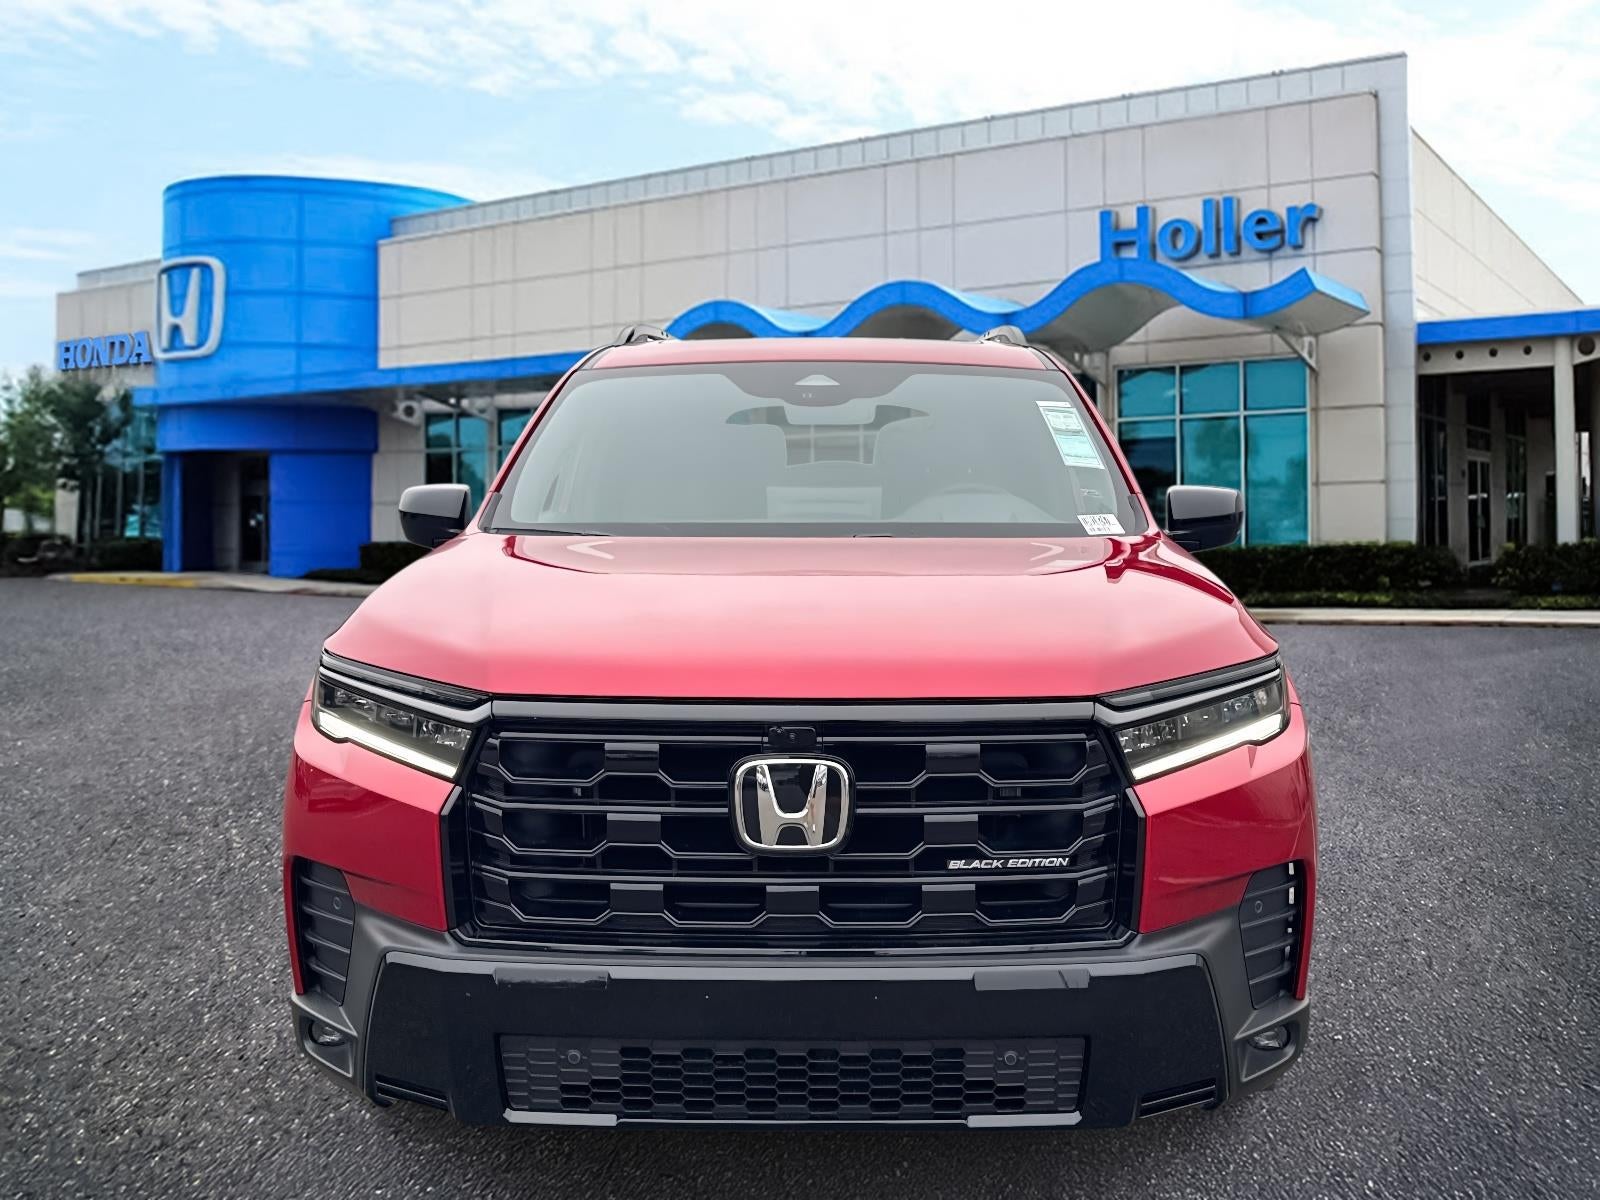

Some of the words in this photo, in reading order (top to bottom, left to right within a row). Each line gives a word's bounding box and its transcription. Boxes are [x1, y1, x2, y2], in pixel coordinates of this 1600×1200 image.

[1099, 196, 1321, 262] Holler
[57, 331, 152, 371] HONDA
[947, 859, 1004, 870] BLACK
[1006, 857, 1070, 868] EDITION
